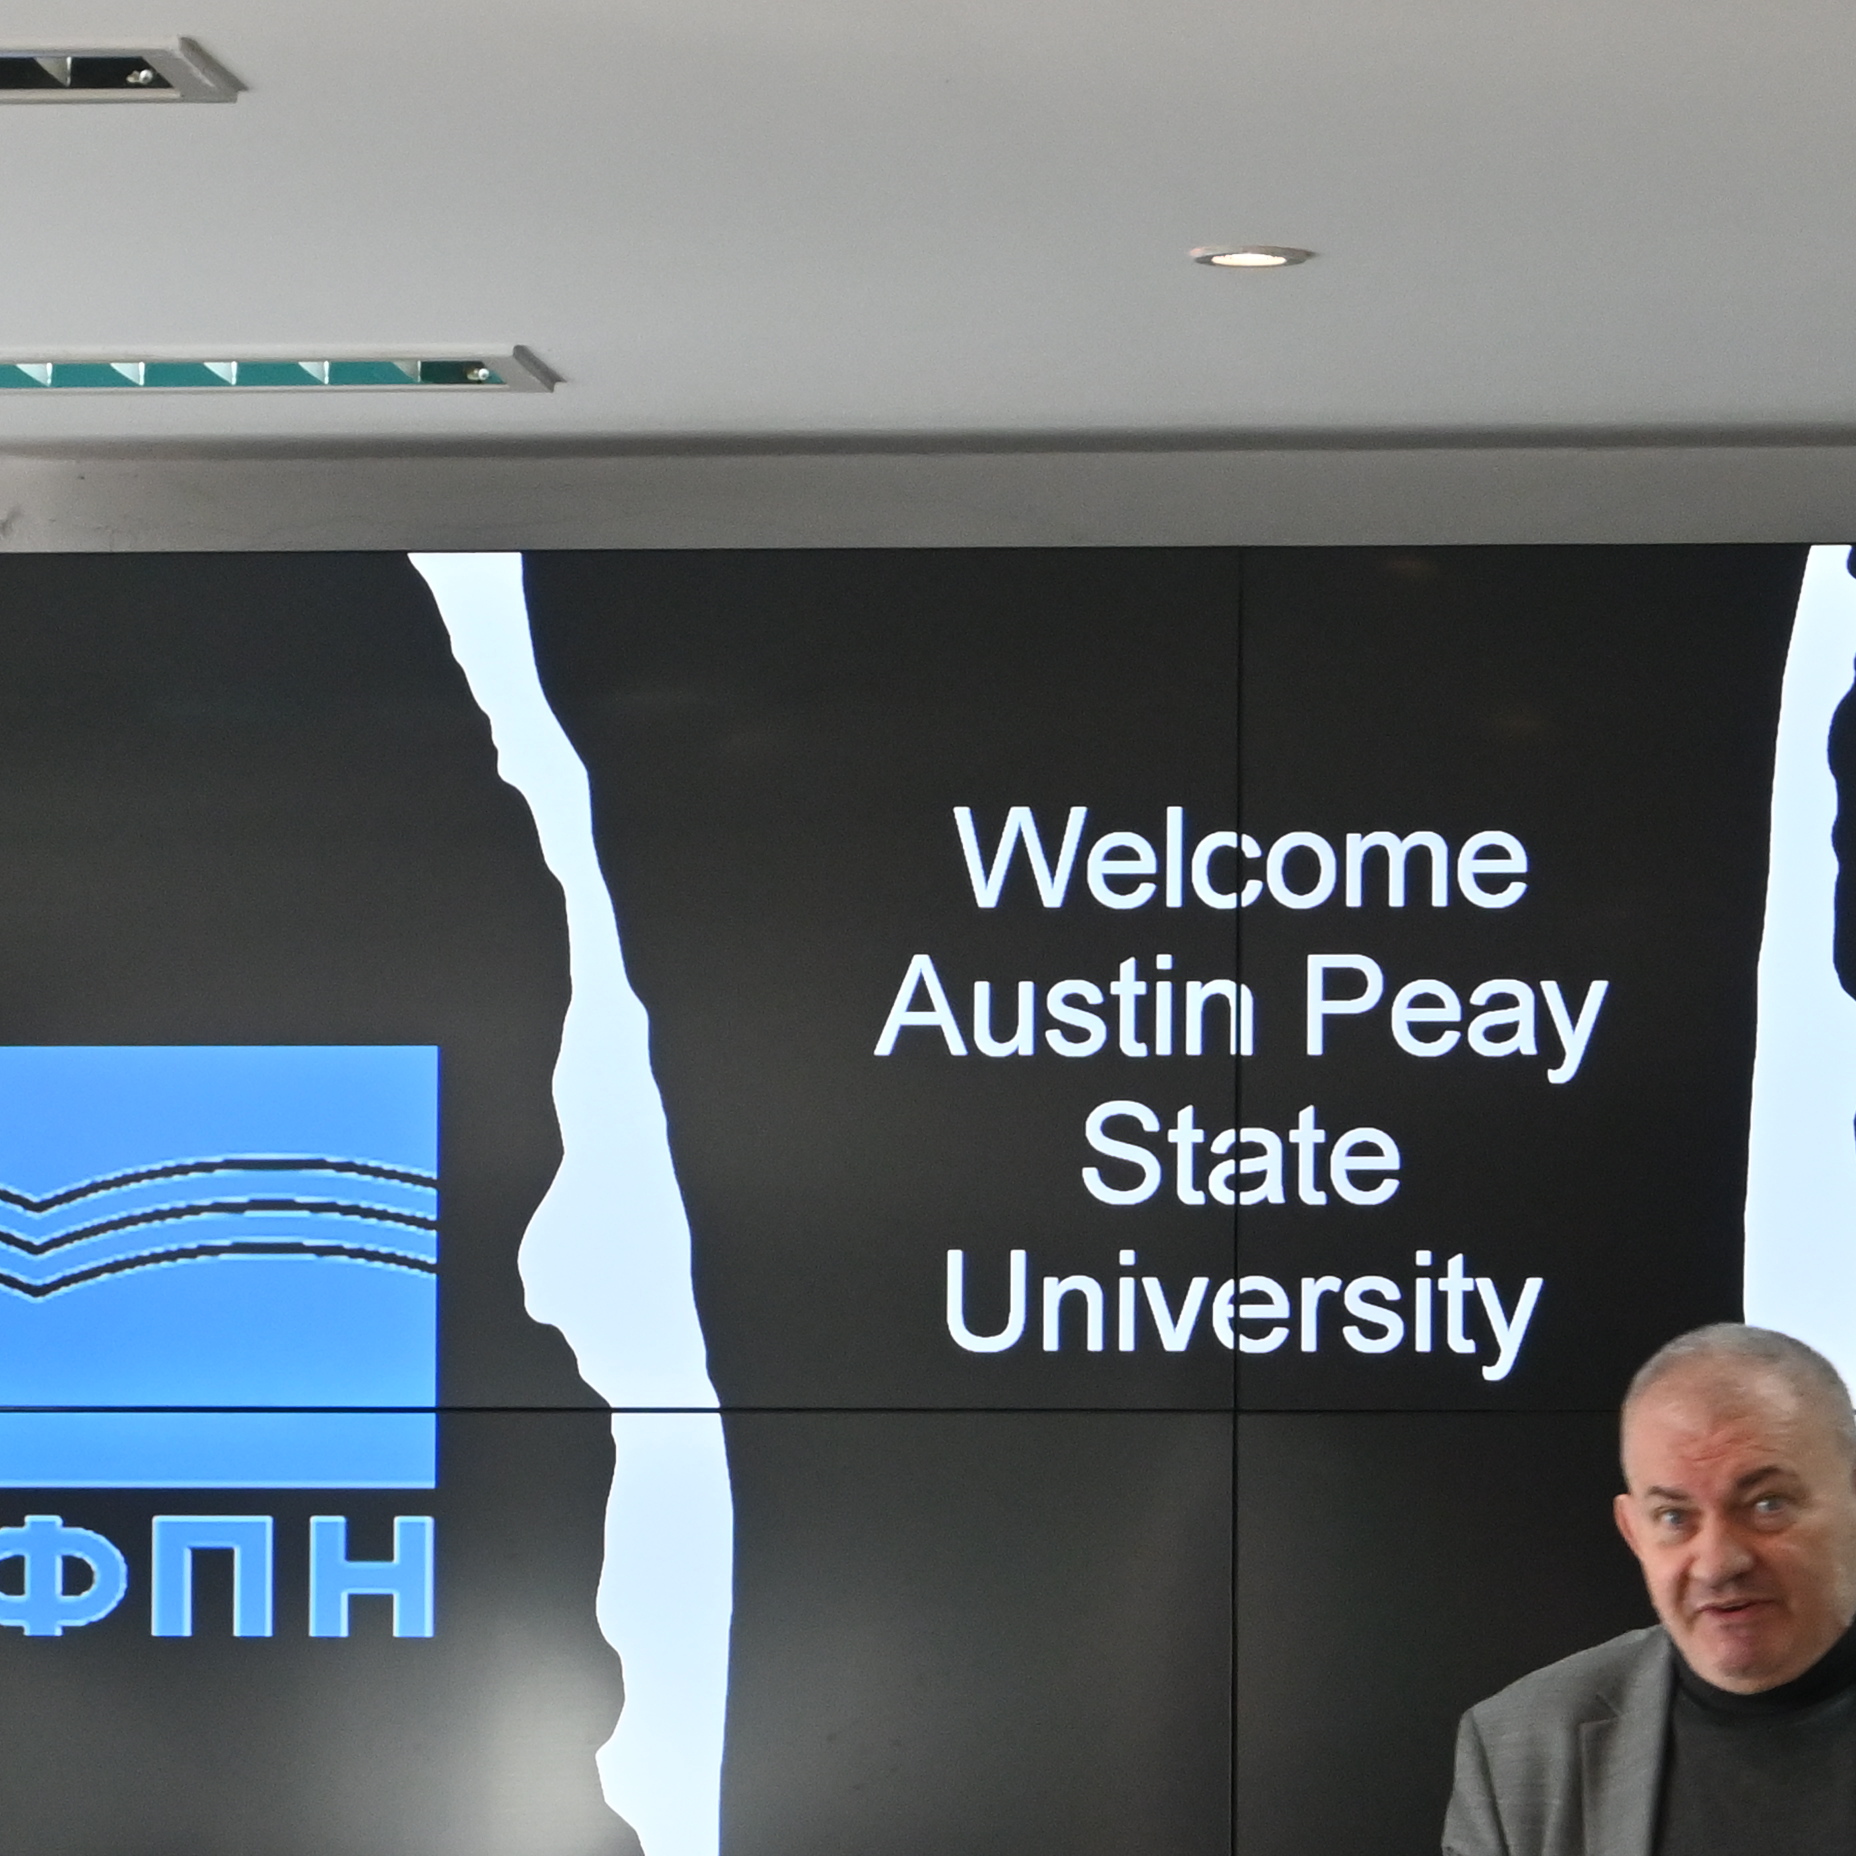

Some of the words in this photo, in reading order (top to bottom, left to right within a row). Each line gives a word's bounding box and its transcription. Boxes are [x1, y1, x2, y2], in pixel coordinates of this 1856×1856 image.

[953, 805, 1528, 910] Welcome
[874, 953, 1254, 1058] Austin
[1306, 953, 1609, 1085] Peay
[1081, 1099, 1401, 1206] State
[946, 1248, 1544, 1382] University
